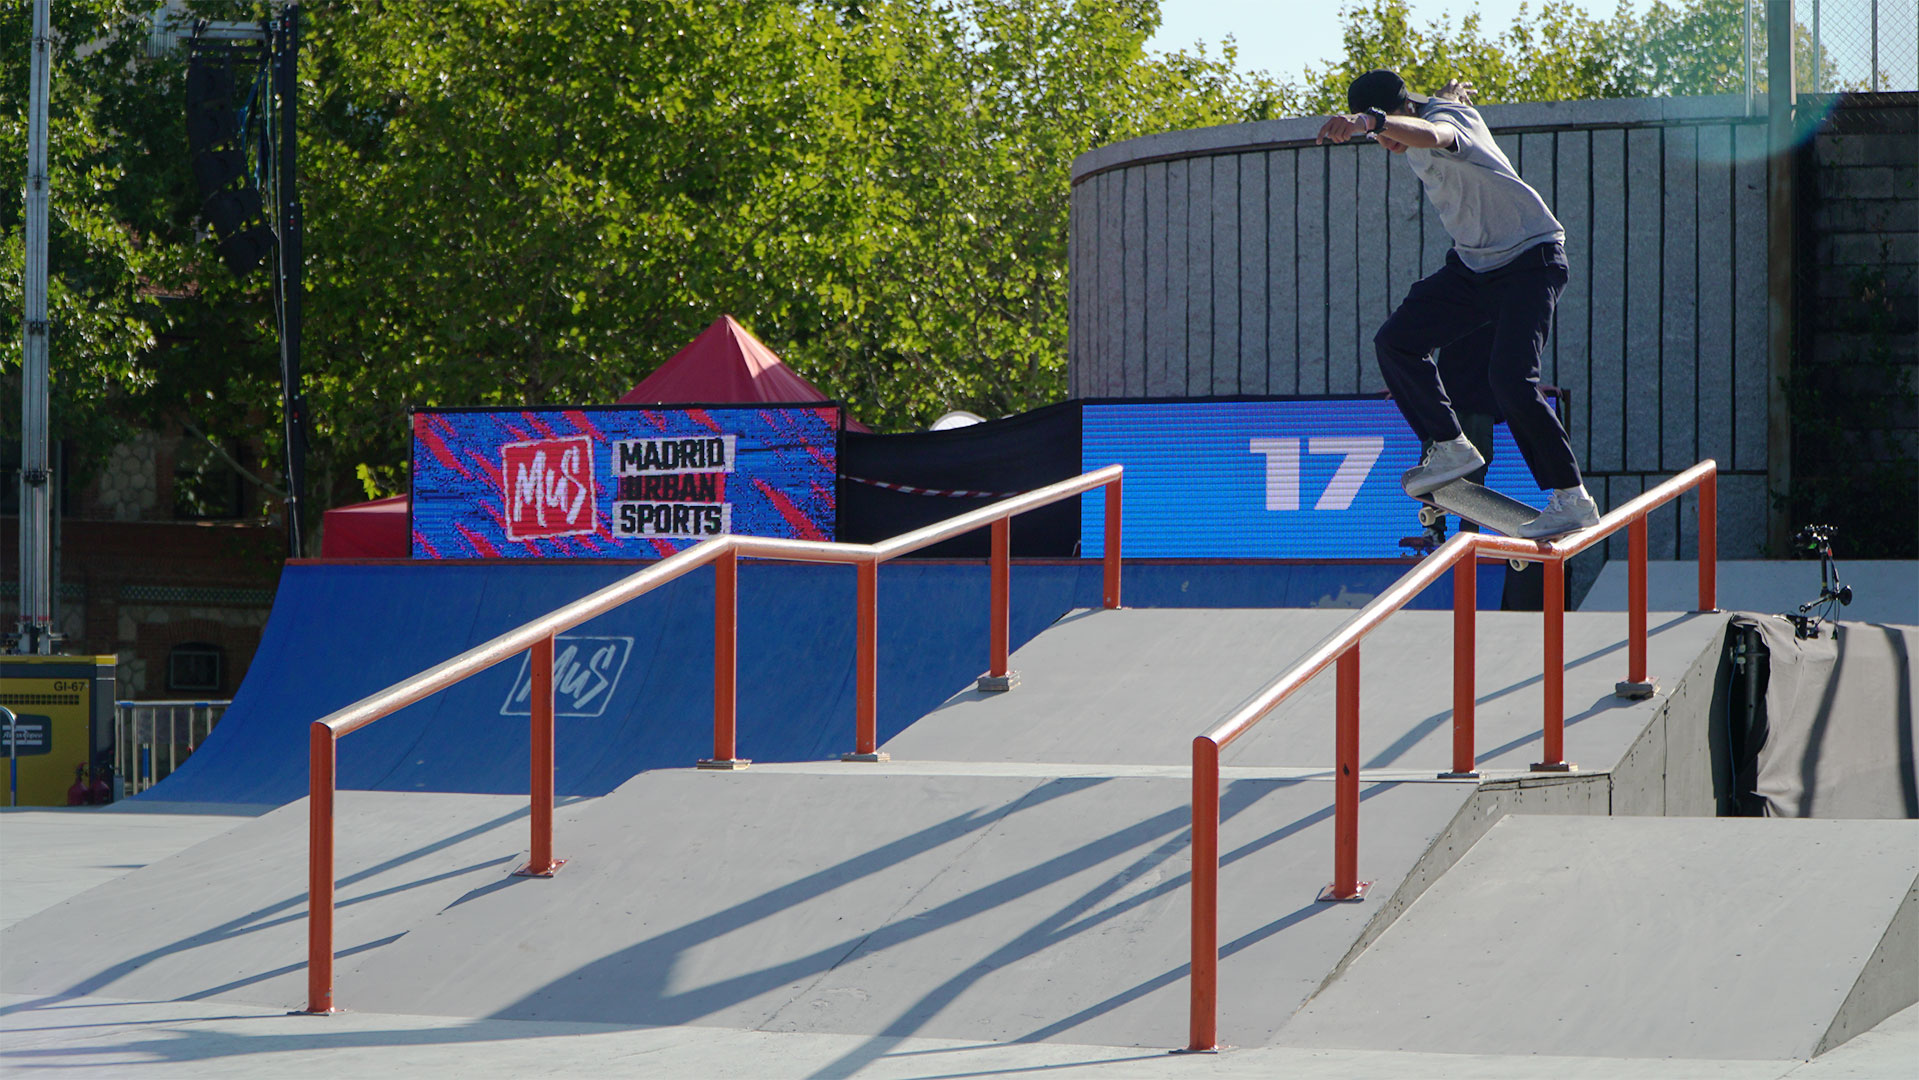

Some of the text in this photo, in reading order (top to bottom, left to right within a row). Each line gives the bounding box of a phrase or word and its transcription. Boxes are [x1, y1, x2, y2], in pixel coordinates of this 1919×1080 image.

[618, 437, 725, 472] MADRID
[618, 473, 716, 502] URBAN
[1250, 436, 1385, 511] 17
[619, 503, 723, 535] SPORTS
[53, 681, 86, 692] GI-67
